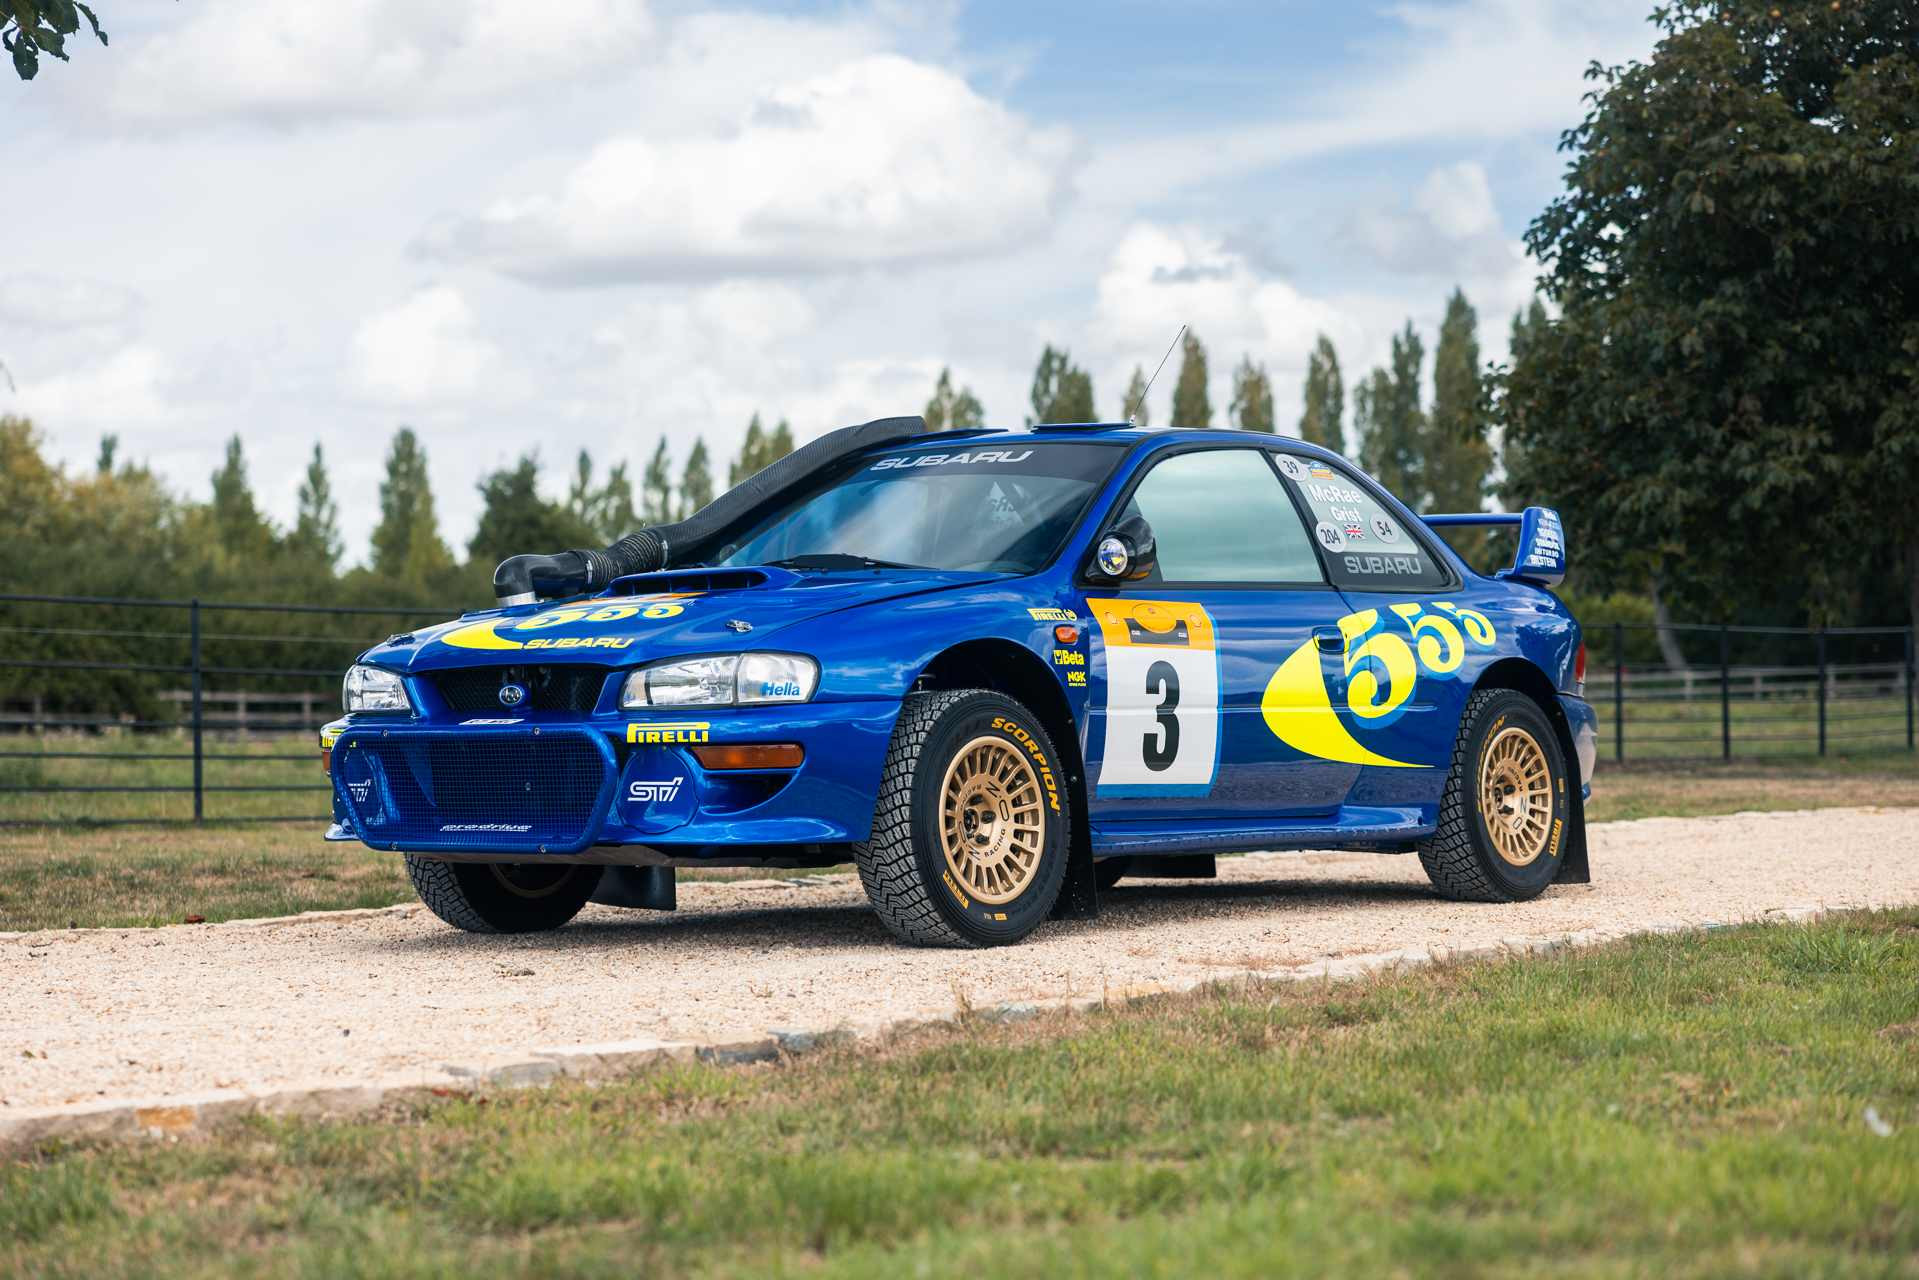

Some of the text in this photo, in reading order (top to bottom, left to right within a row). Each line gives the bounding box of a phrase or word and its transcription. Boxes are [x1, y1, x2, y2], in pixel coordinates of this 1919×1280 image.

[870, 450, 1034, 472] SUBARU
[1283, 460, 1299, 474] 39
[1308, 484, 1363, 504] McRae
[1330, 506, 1363, 523] Grist
[1320, 528, 1341, 545] 204
[1376, 521, 1393, 536] 54
[1344, 556, 1422, 575] SUBARU
[513, 603, 685, 630] 555
[524, 637, 635, 649] SUBARU
[1062, 649, 1085, 665] Beta
[1337, 601, 1497, 719] 555
[1066, 671, 1086, 682] NGK
[761, 682, 801, 696] Hella
[1142, 660, 1180, 772] 3
[626, 722, 712, 743] PIRELLI
[991, 717, 1061, 813] SCORPION
[984, 828, 1006, 858] RACING
